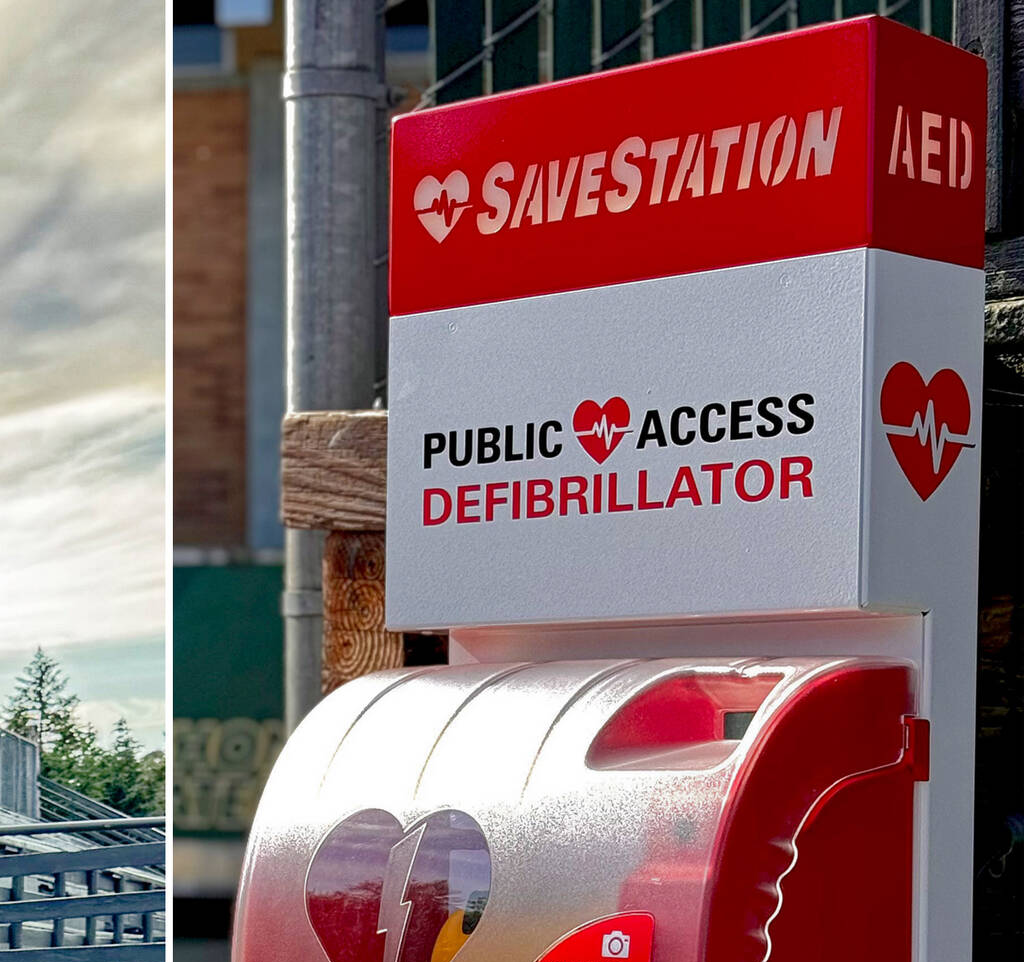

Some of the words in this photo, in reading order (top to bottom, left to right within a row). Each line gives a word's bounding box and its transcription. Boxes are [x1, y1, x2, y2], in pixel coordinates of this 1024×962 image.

[476, 106, 842, 235] SAVESTATION
[888, 105, 972, 191] AED
[422, 420, 564, 468] PUBLIC
[636, 393, 814, 449] ACCESS
[422, 456, 814, 527] DEFIBRILLATOR
